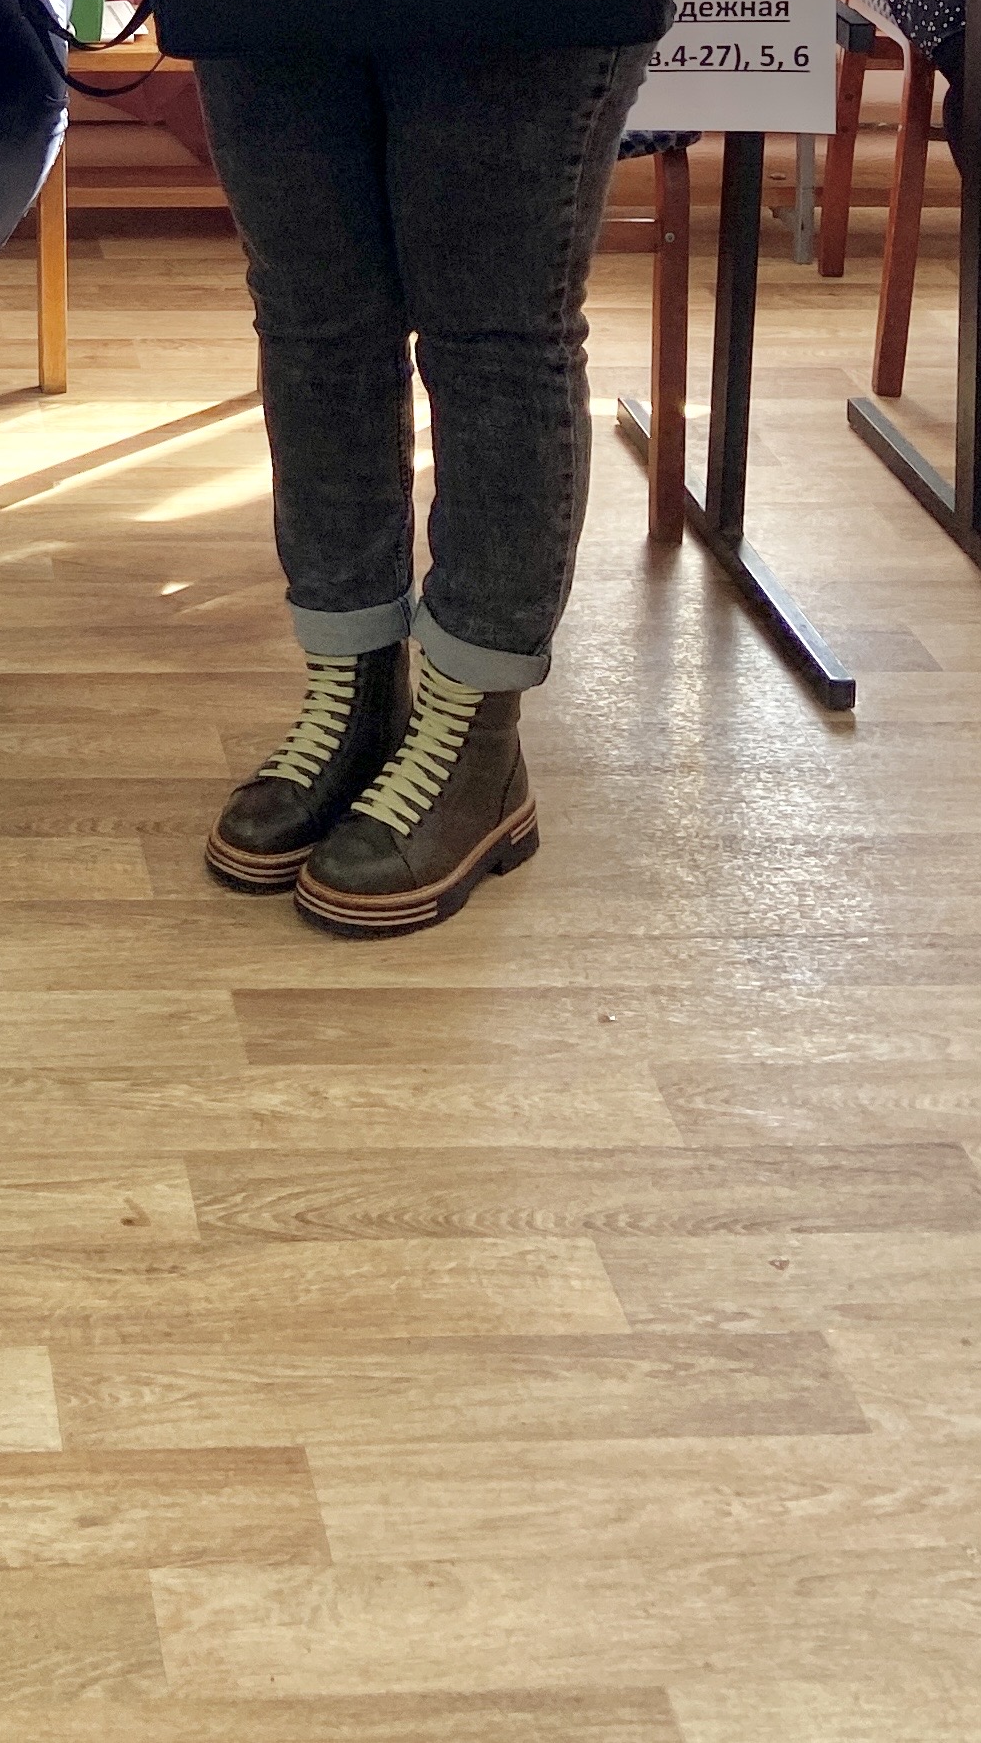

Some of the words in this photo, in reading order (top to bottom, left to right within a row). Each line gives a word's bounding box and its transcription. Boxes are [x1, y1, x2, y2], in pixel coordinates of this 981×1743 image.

[673, 0, 789, 22] дежная
[760, 45, 784, 70] 5,
[793, 45, 810, 67] 6
